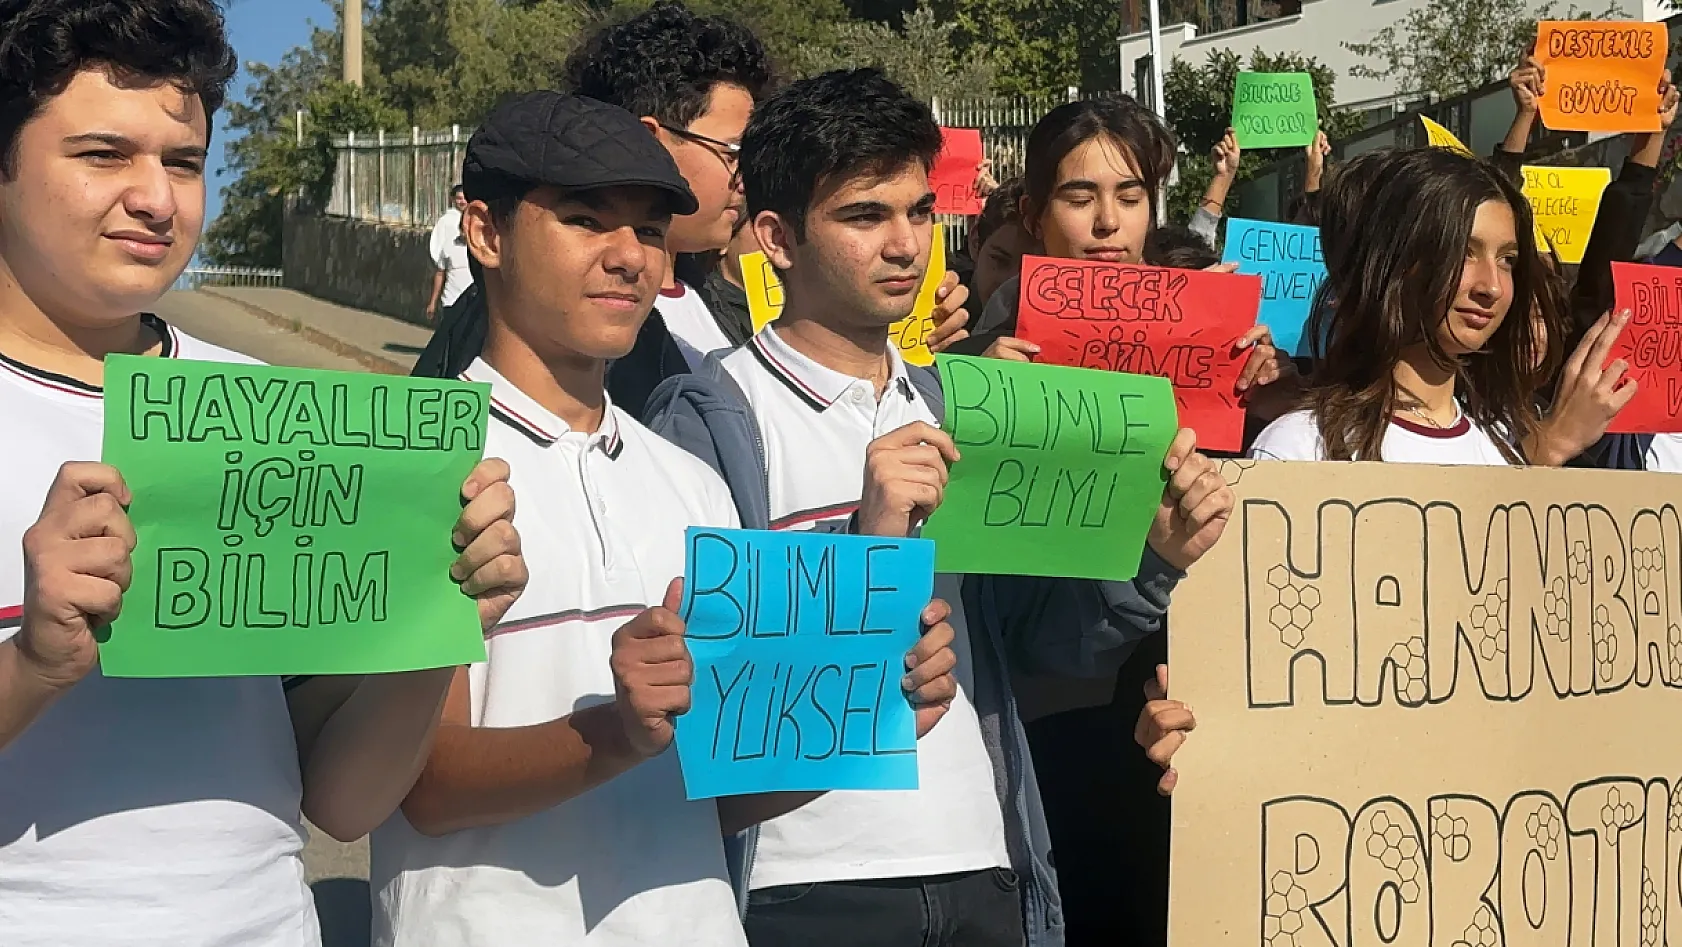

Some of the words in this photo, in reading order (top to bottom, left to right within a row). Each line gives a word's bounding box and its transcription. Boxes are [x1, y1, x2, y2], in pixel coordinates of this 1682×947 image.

[1549, 29, 1653, 58] DESTEKLE
[1241, 115, 1273, 134] YOL
[1559, 80, 1637, 115] BÜYÜT
[1547, 172, 1564, 189] OL
[1028, 264, 1188, 322] GELECEK
[1257, 270, 1324, 300] ÜVEN
[1634, 326, 1682, 371] GÜ
[130, 372, 481, 451] HAYALLER
[946, 358, 1150, 454] BİLİMLE
[217, 449, 364, 537] İÇİN
[154, 535, 390, 630] BİLİM
[684, 532, 900, 640] BİLİMLE
[711, 659, 917, 762] YÜKSEL
[1261, 776, 1682, 947] ROBOTI
